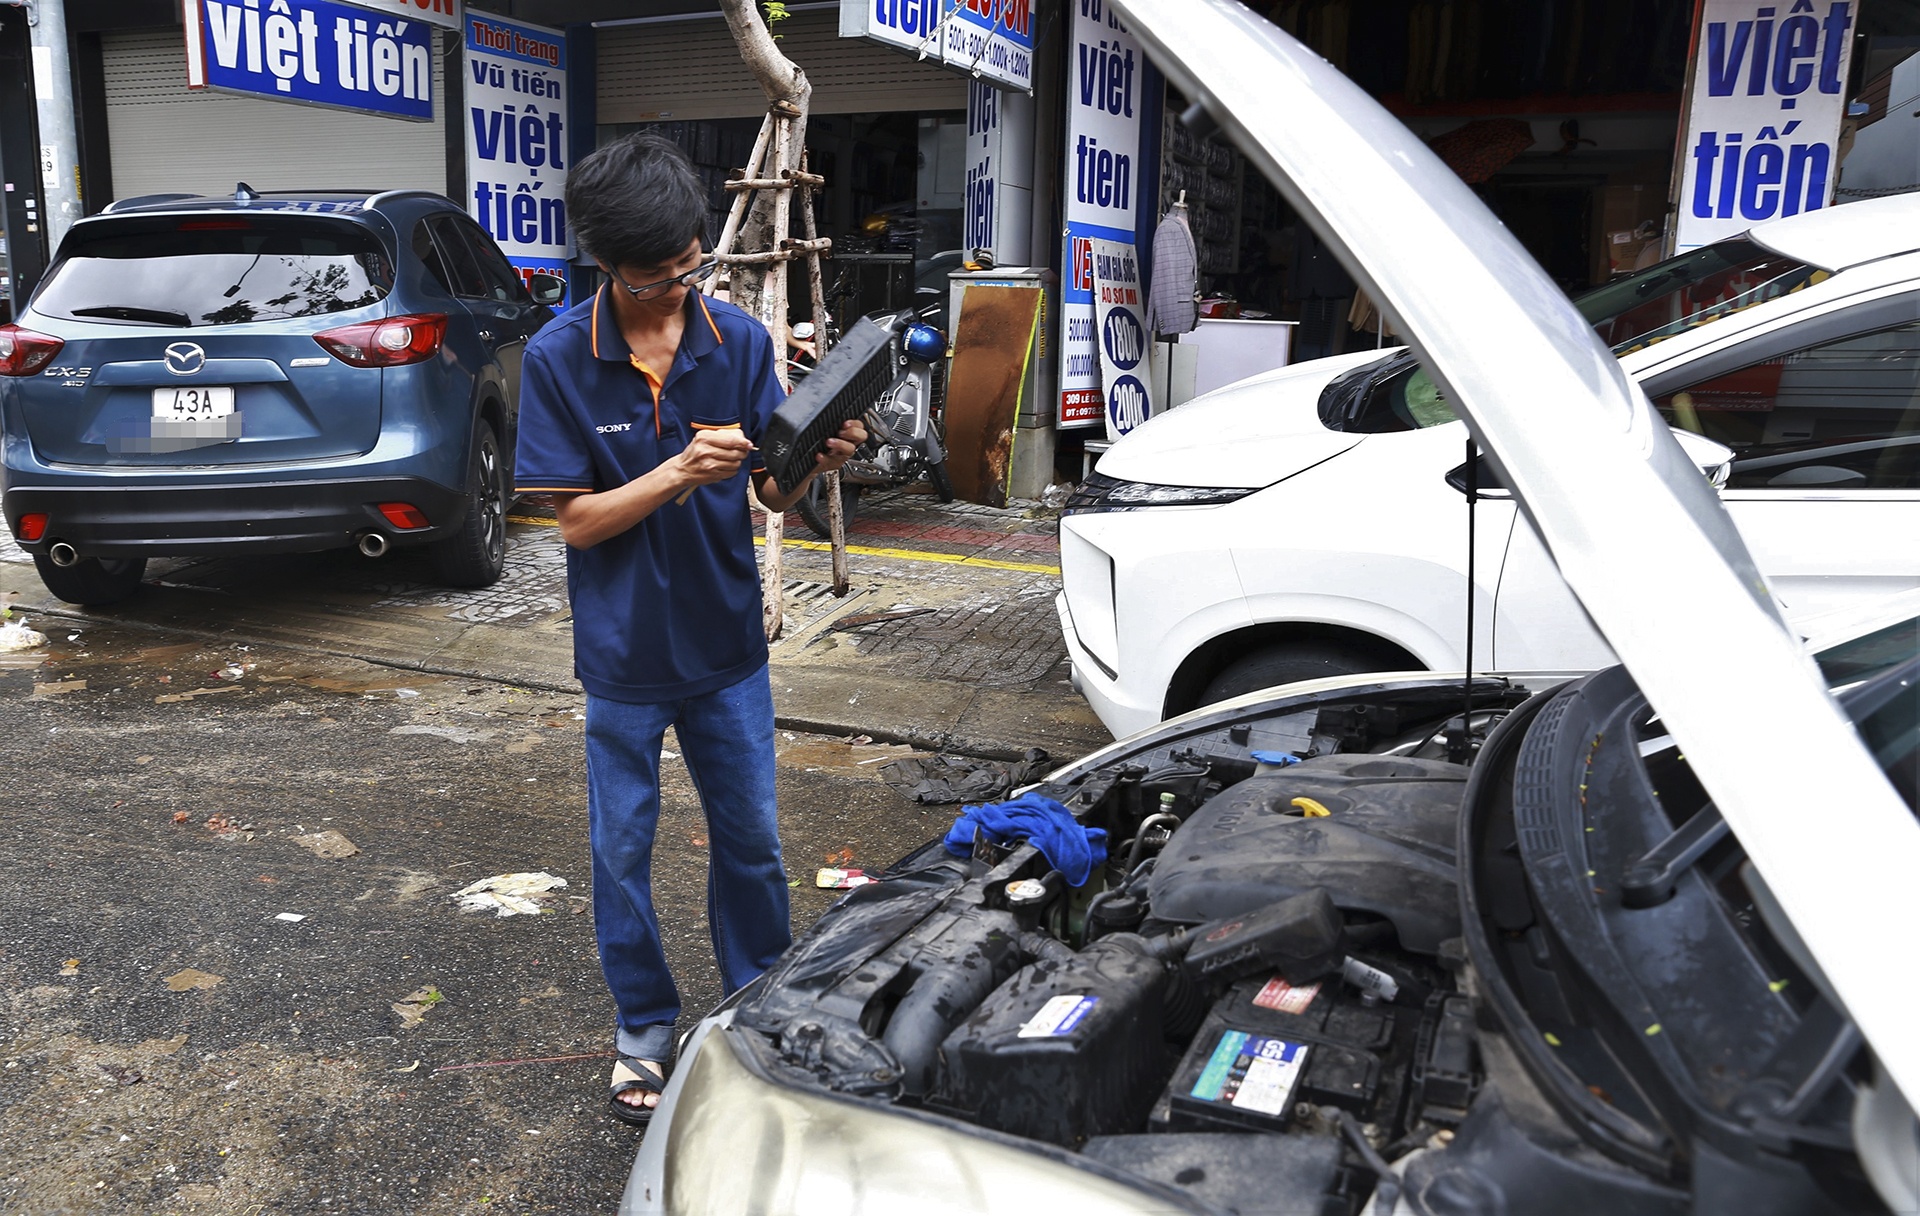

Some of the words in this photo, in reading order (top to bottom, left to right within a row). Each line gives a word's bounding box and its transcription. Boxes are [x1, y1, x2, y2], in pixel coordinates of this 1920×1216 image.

[207, 0, 320, 92] việt
[334, 17, 430, 102] tiến
[472, 21, 511, 52] Thời
[514, 32, 559, 67] trang
[1707, 0, 1852, 110] việt
[471, 59, 505, 89] Vũ
[511, 68, 561, 100] tiến
[471, 104, 564, 177] việt
[1077, 134, 1130, 210] tien
[1692, 120, 1830, 221] tiến
[474, 181, 566, 246] tiến
[966, 156, 994, 250] tiến
[1102, 283, 1112, 304] ÁO
[1125, 288, 1138, 305] MI
[44, 366, 92, 378] CX-5
[173, 390, 213, 413] 43A
[1066, 393, 1080, 405] 309
[595, 423, 632, 434] SONY
[1260, 1040, 1286, 1060] GS
